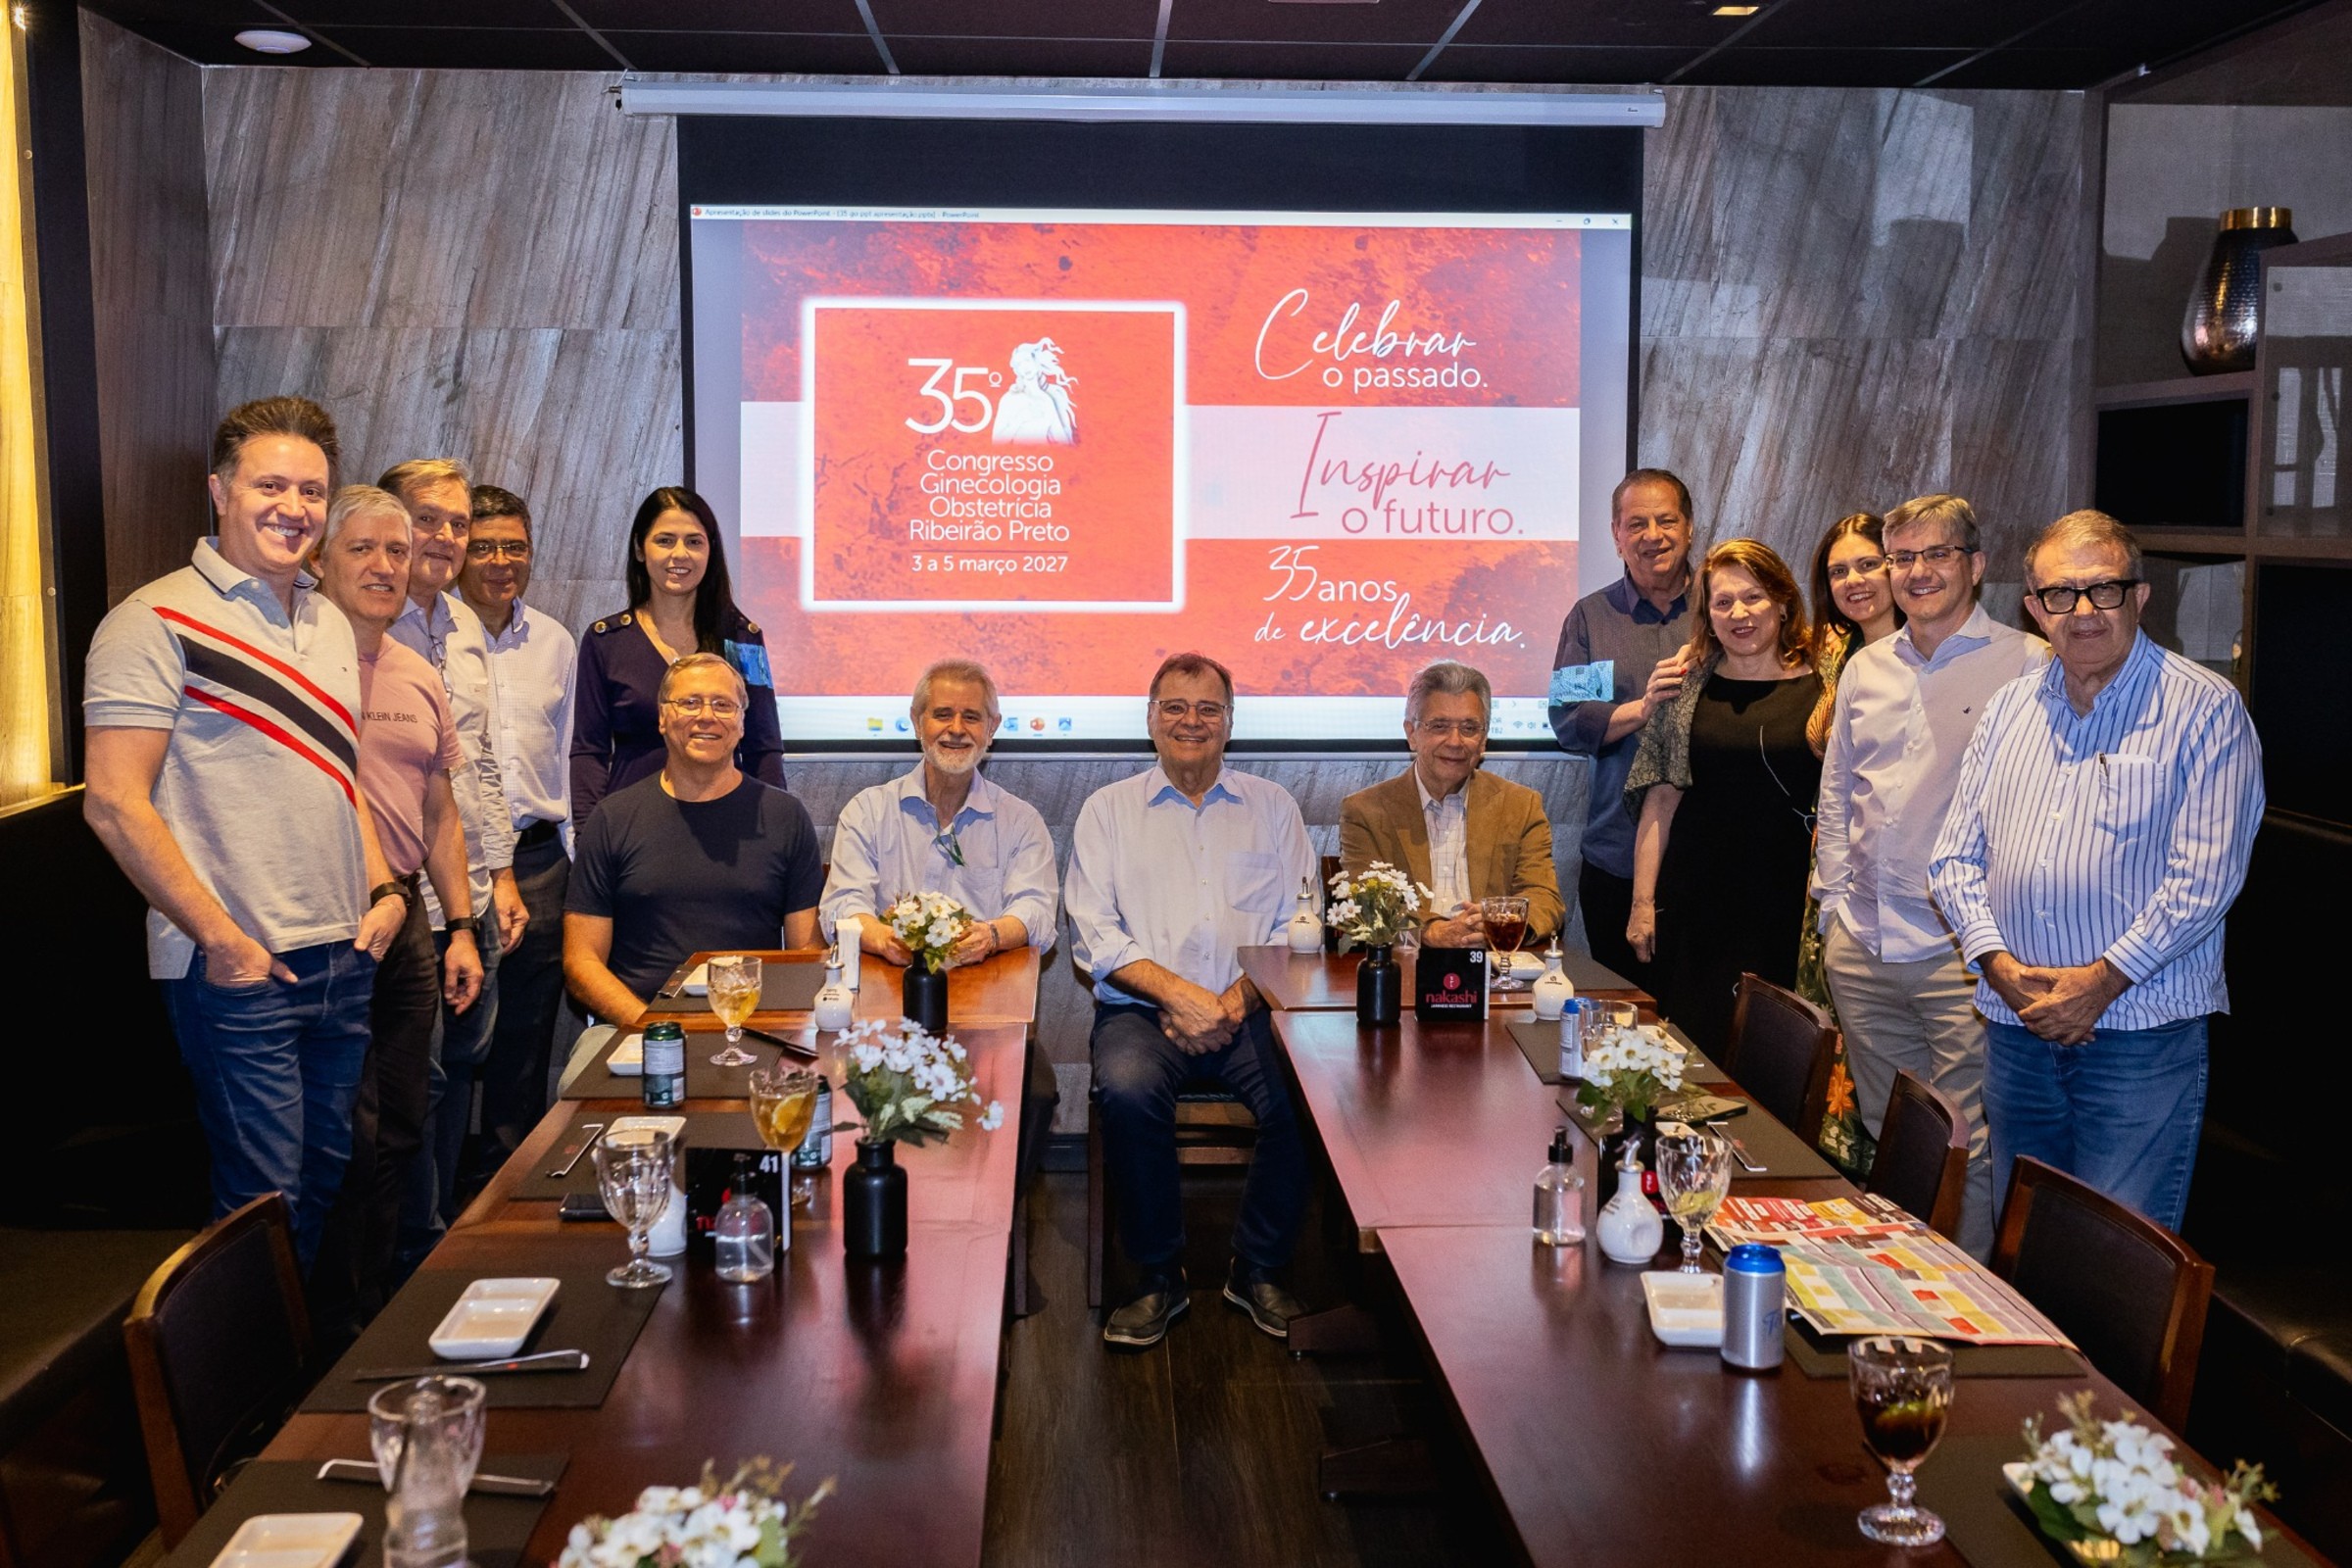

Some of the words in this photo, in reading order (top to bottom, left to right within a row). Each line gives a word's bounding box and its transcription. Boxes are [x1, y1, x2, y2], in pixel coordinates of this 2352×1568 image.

[1254, 288, 1477, 380] Celebrar
[1323, 368, 1343, 387] o
[1353, 362, 1489, 394] passado.
[927, 449, 1054, 475] Congresso
[1290, 412, 1511, 519] Inspirar
[920, 472, 1061, 500] Ginecologia
[929, 496, 1052, 517] Obstetrícia
[1342, 507, 1368, 534] o
[1383, 498, 1524, 535] futuro.
[909, 519, 1003, 541] Ribeirão
[1008, 520, 1070, 542] Preto
[911, 556, 922, 571] 3
[927, 559, 938, 571] a
[943, 556, 955, 572] 5
[959, 559, 1017, 575] março
[1022, 556, 1068, 572] 2027
[1262, 545, 1320, 602] 35
[1318, 580, 1397, 603] anos
[1254, 612, 1287, 643] de
[1299, 592, 1526, 650] excelência.
[367, 712, 390, 721] KLEIN
[393, 712, 418, 723] JEANS
[1470, 952, 1483, 962] 39
[1425, 990, 1478, 1004] nakashi
[760, 1155, 778, 1173] 41
